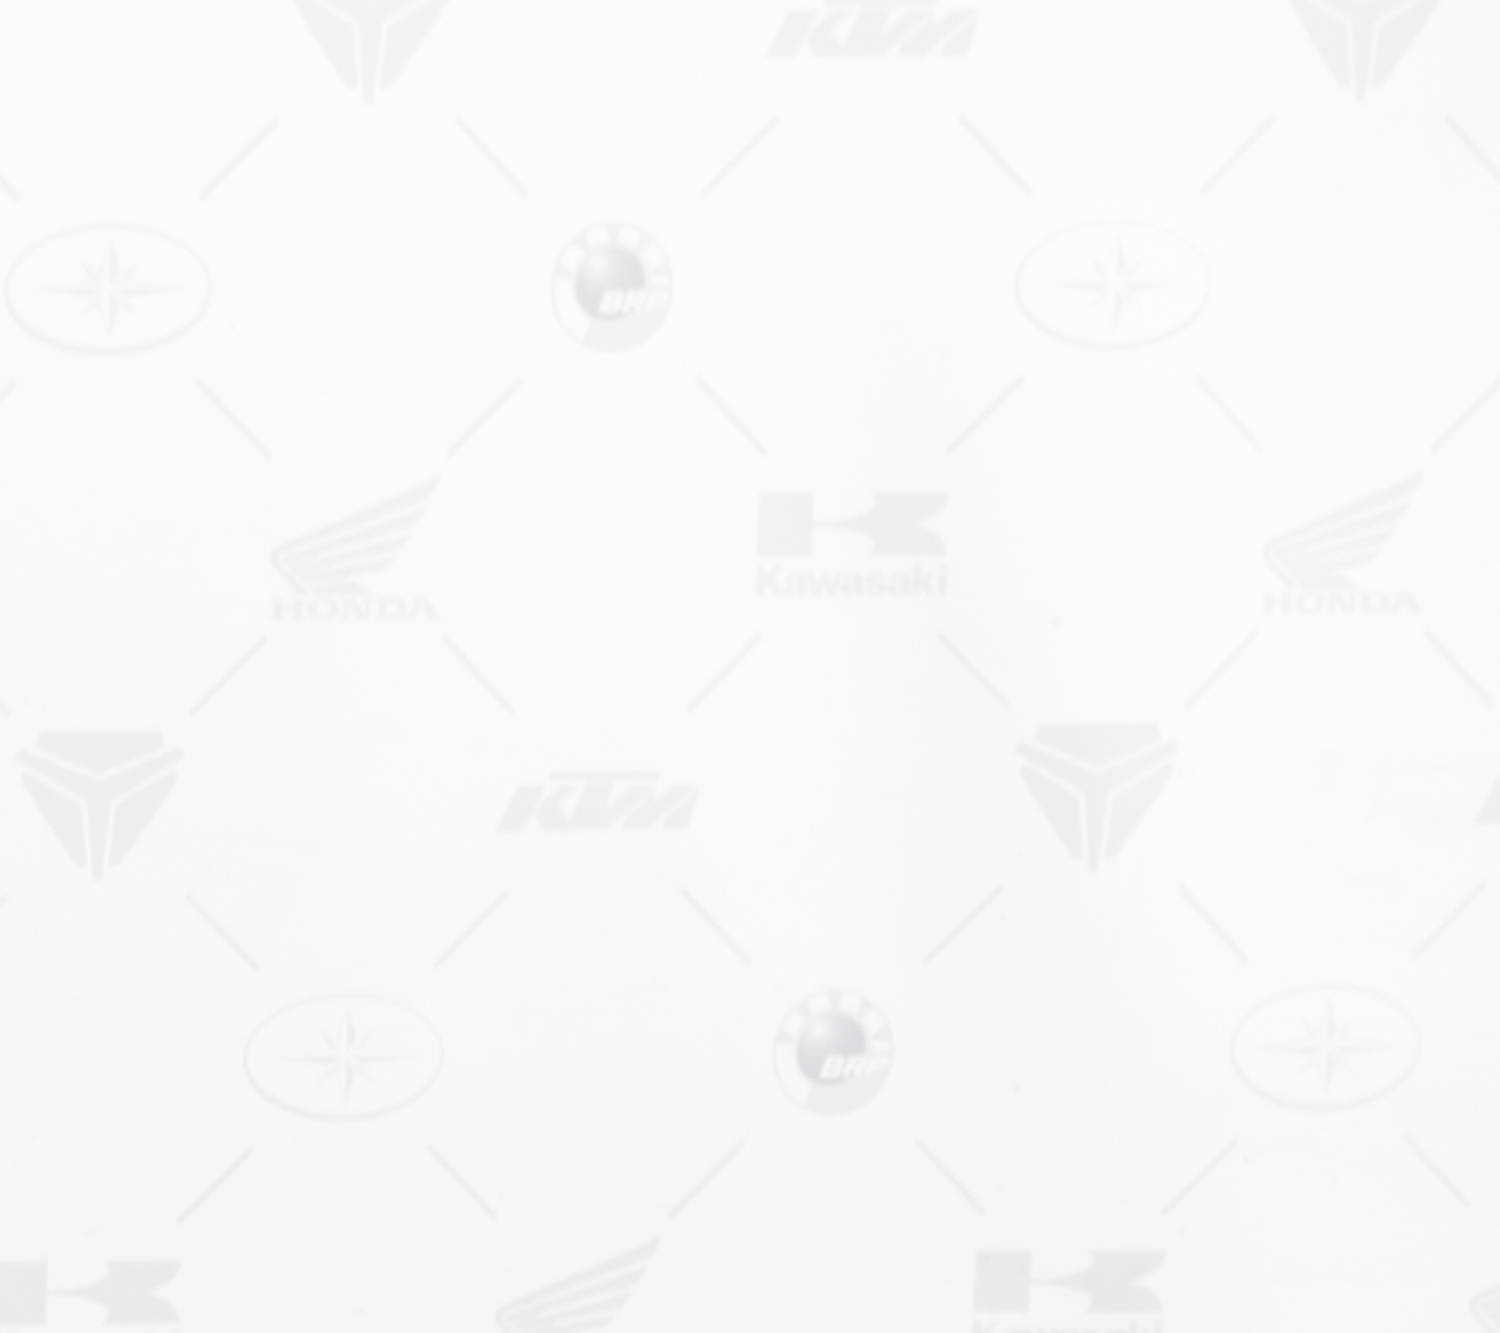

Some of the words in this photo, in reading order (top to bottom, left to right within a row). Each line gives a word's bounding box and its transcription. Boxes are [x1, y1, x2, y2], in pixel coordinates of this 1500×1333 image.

[768, 0, 978, 58] KTM
[598, 289, 671, 314] BRP
[756, 562, 949, 597] Kawasaki
[269, 598, 442, 621] HONDA
[1262, 591, 1426, 614] HONDA
[496, 770, 699, 833] KTM
[818, 1053, 893, 1077] BRP
